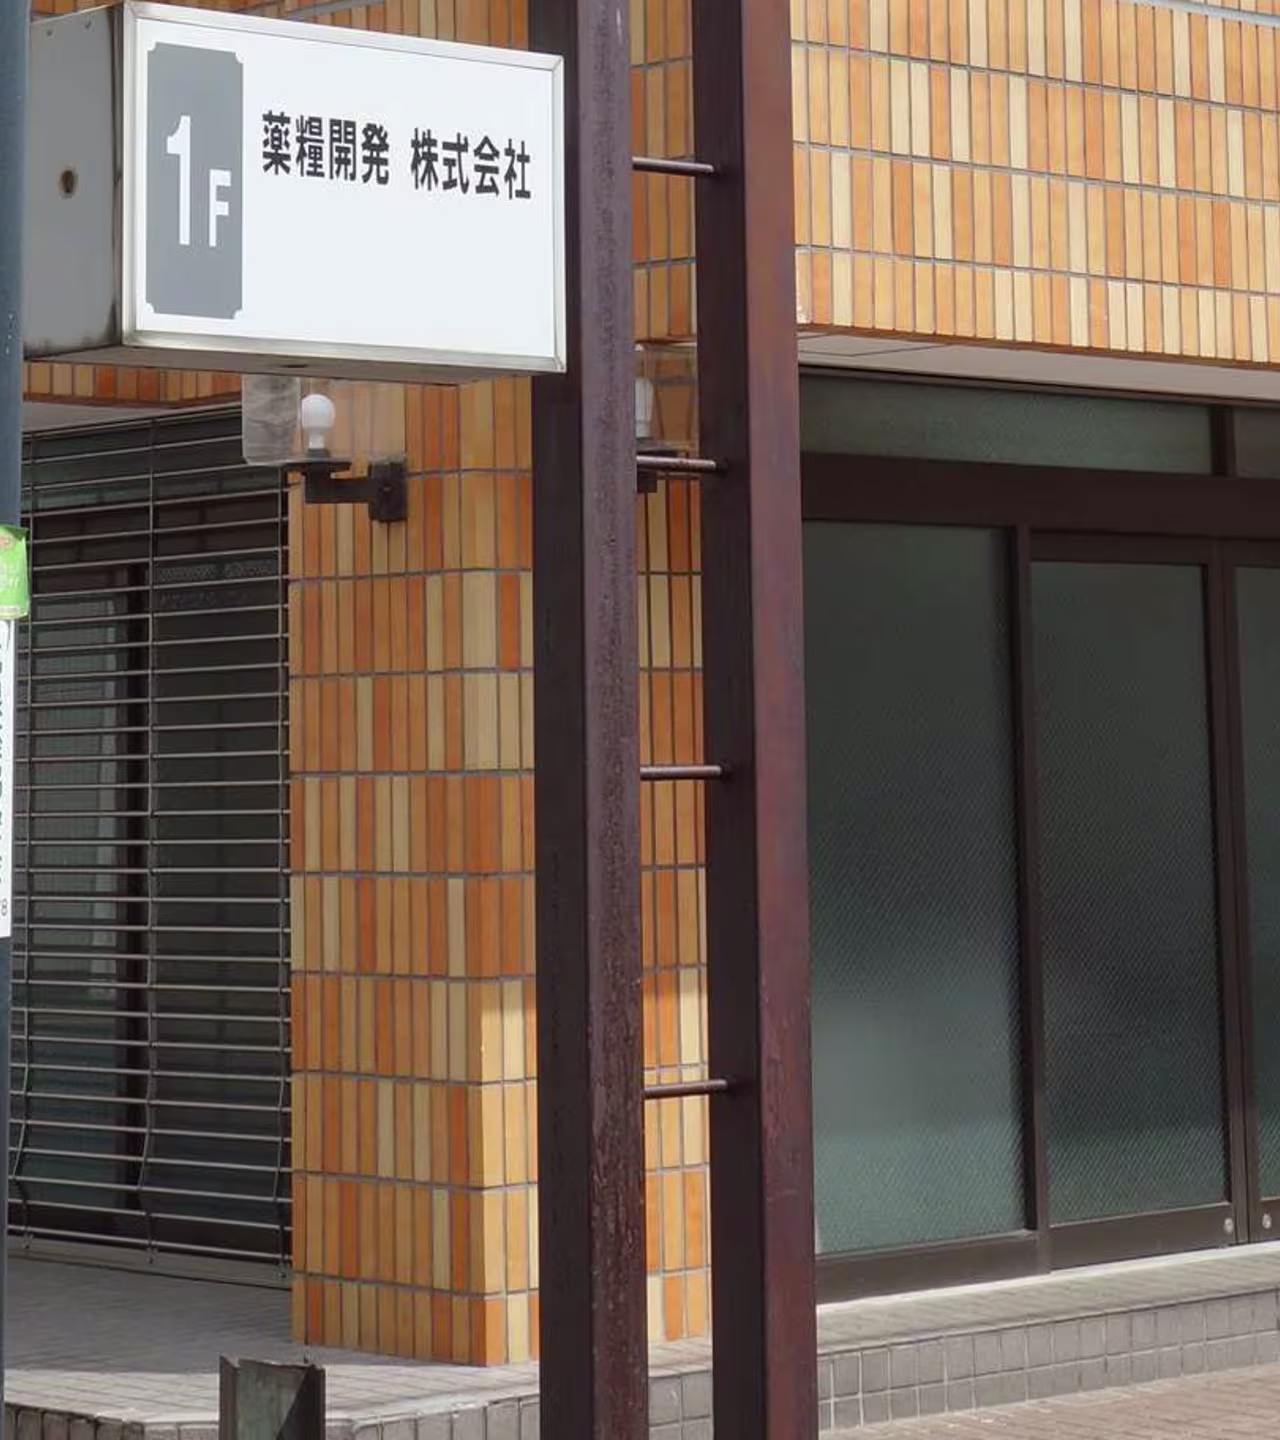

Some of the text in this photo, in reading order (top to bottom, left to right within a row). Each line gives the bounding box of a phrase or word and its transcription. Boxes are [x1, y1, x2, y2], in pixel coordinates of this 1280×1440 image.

[166, 114, 232, 248] 1F
[262, 109, 532, 201] 薬糧開発 株式会社
